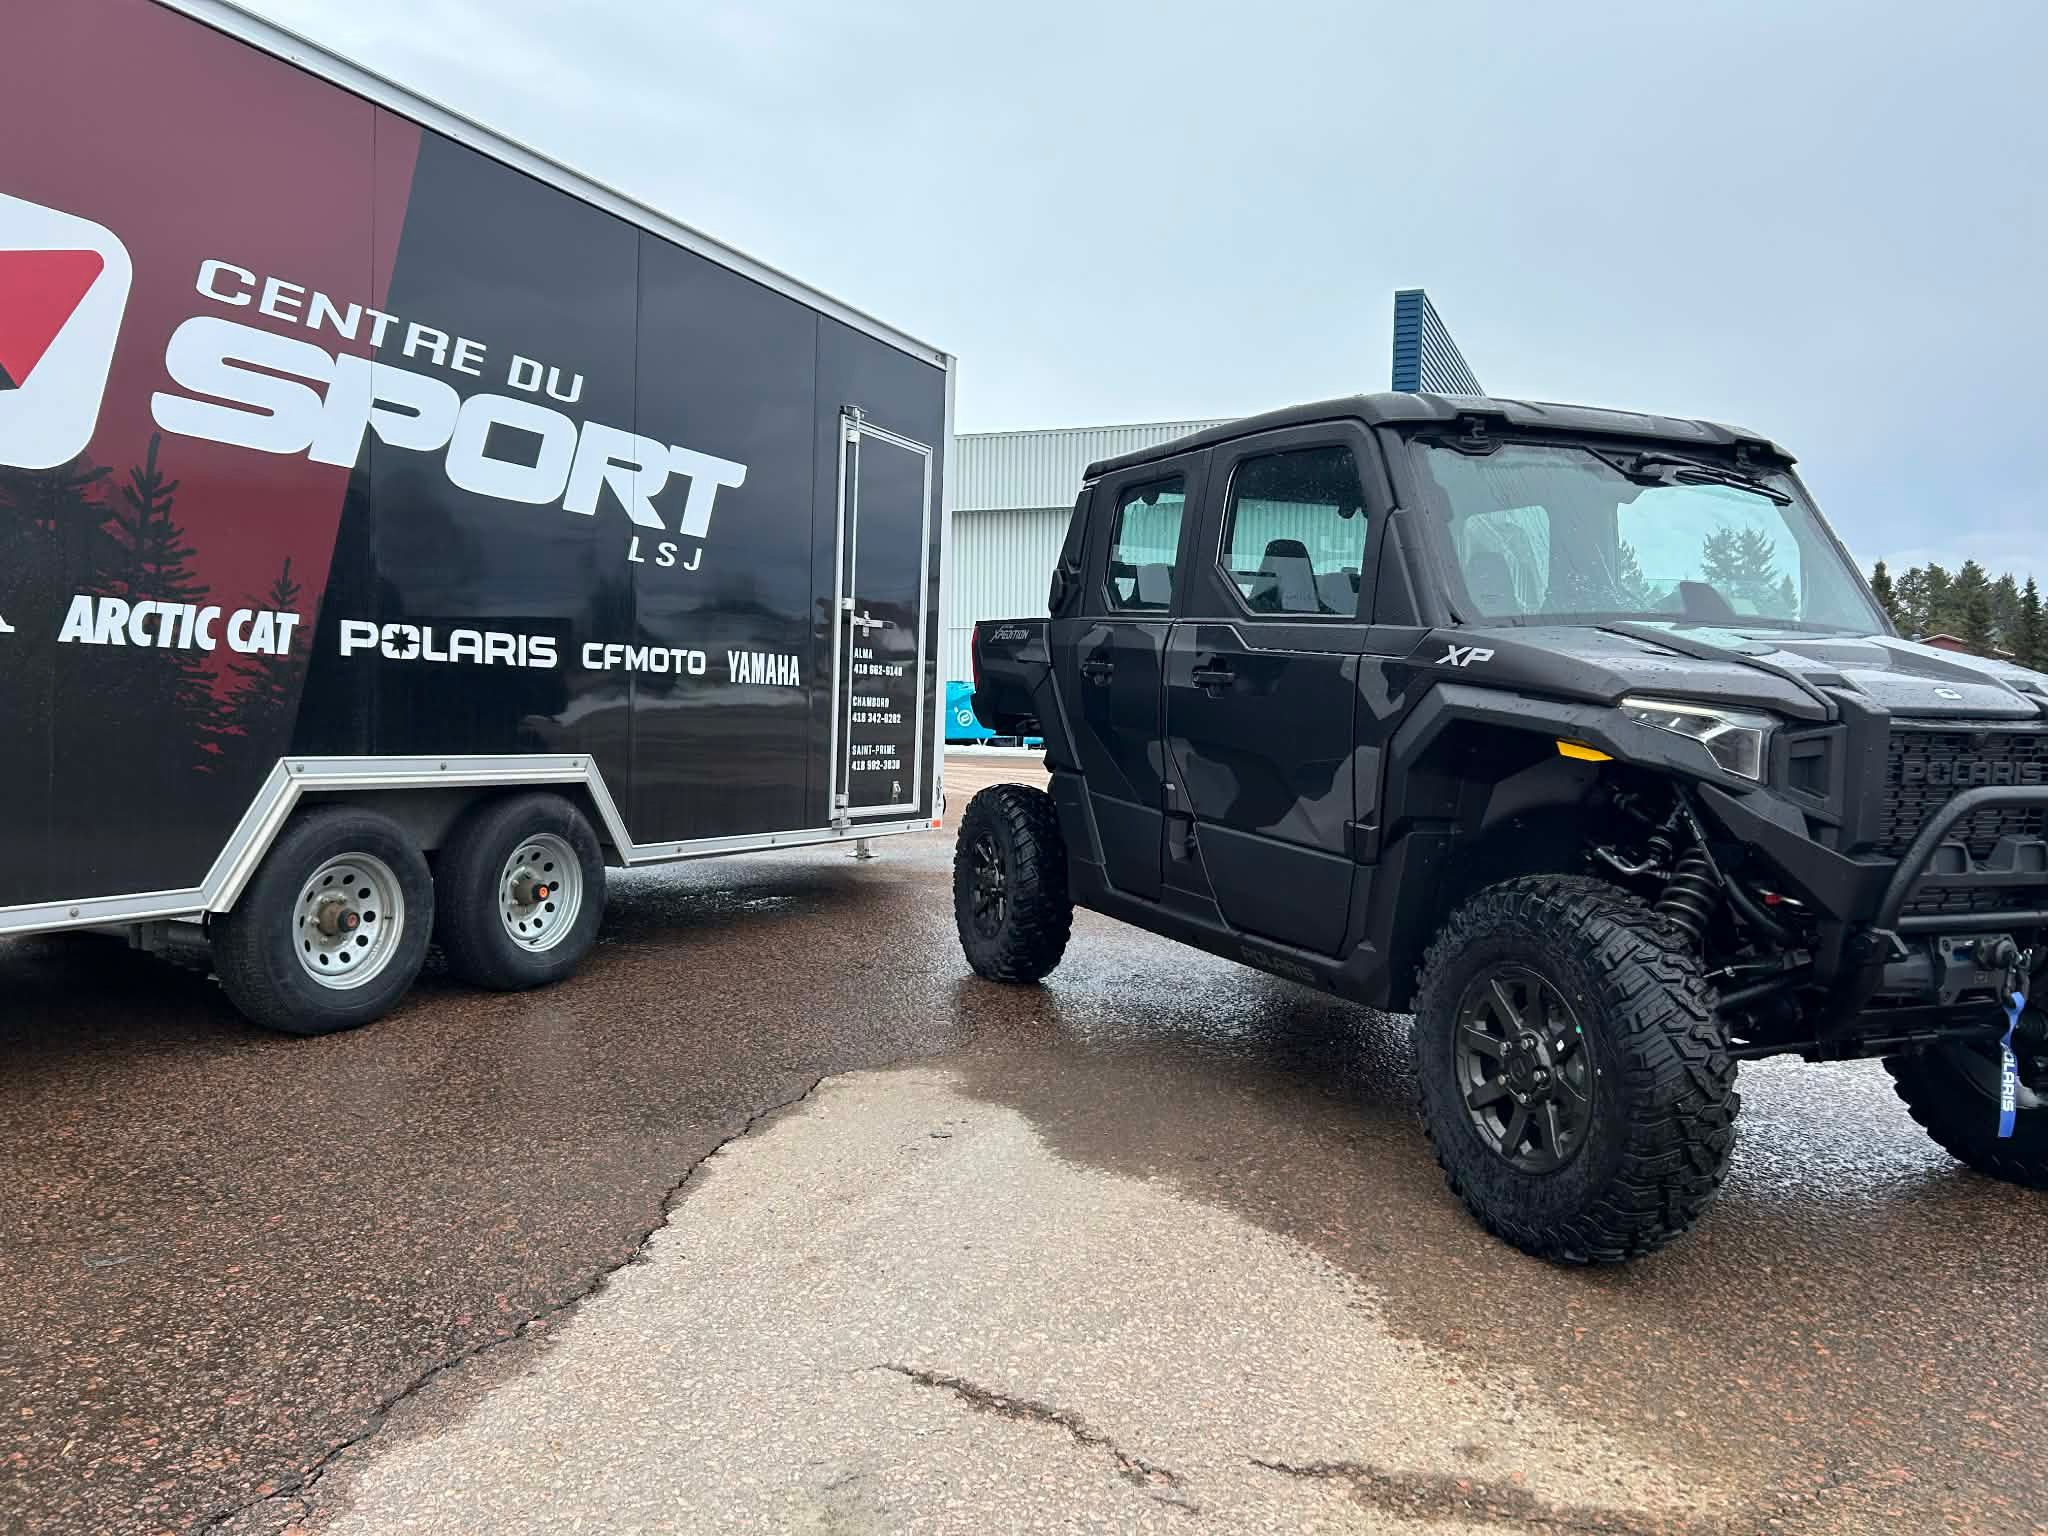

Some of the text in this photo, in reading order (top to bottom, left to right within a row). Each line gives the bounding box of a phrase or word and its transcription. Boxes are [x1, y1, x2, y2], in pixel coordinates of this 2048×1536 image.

[195, 259, 585, 403] CENTRE DU
[151, 316, 748, 539] SPORT
[627, 535, 703, 571] LSJ
[57, 594, 300, 655] ARCTIC CAT
[339, 619, 558, 668] POLARIS
[582, 642, 706, 675] CFMOTO
[854, 648, 873, 660] ALMA
[1434, 645, 1495, 667] XP
[727, 650, 801, 686] YAMAHA
[854, 663, 868, 675] 418
[852, 696, 890, 708] CHAMBORD
[852, 744, 896, 756] SAINT-PRIME
[1902, 760, 2041, 785] POLARIS
